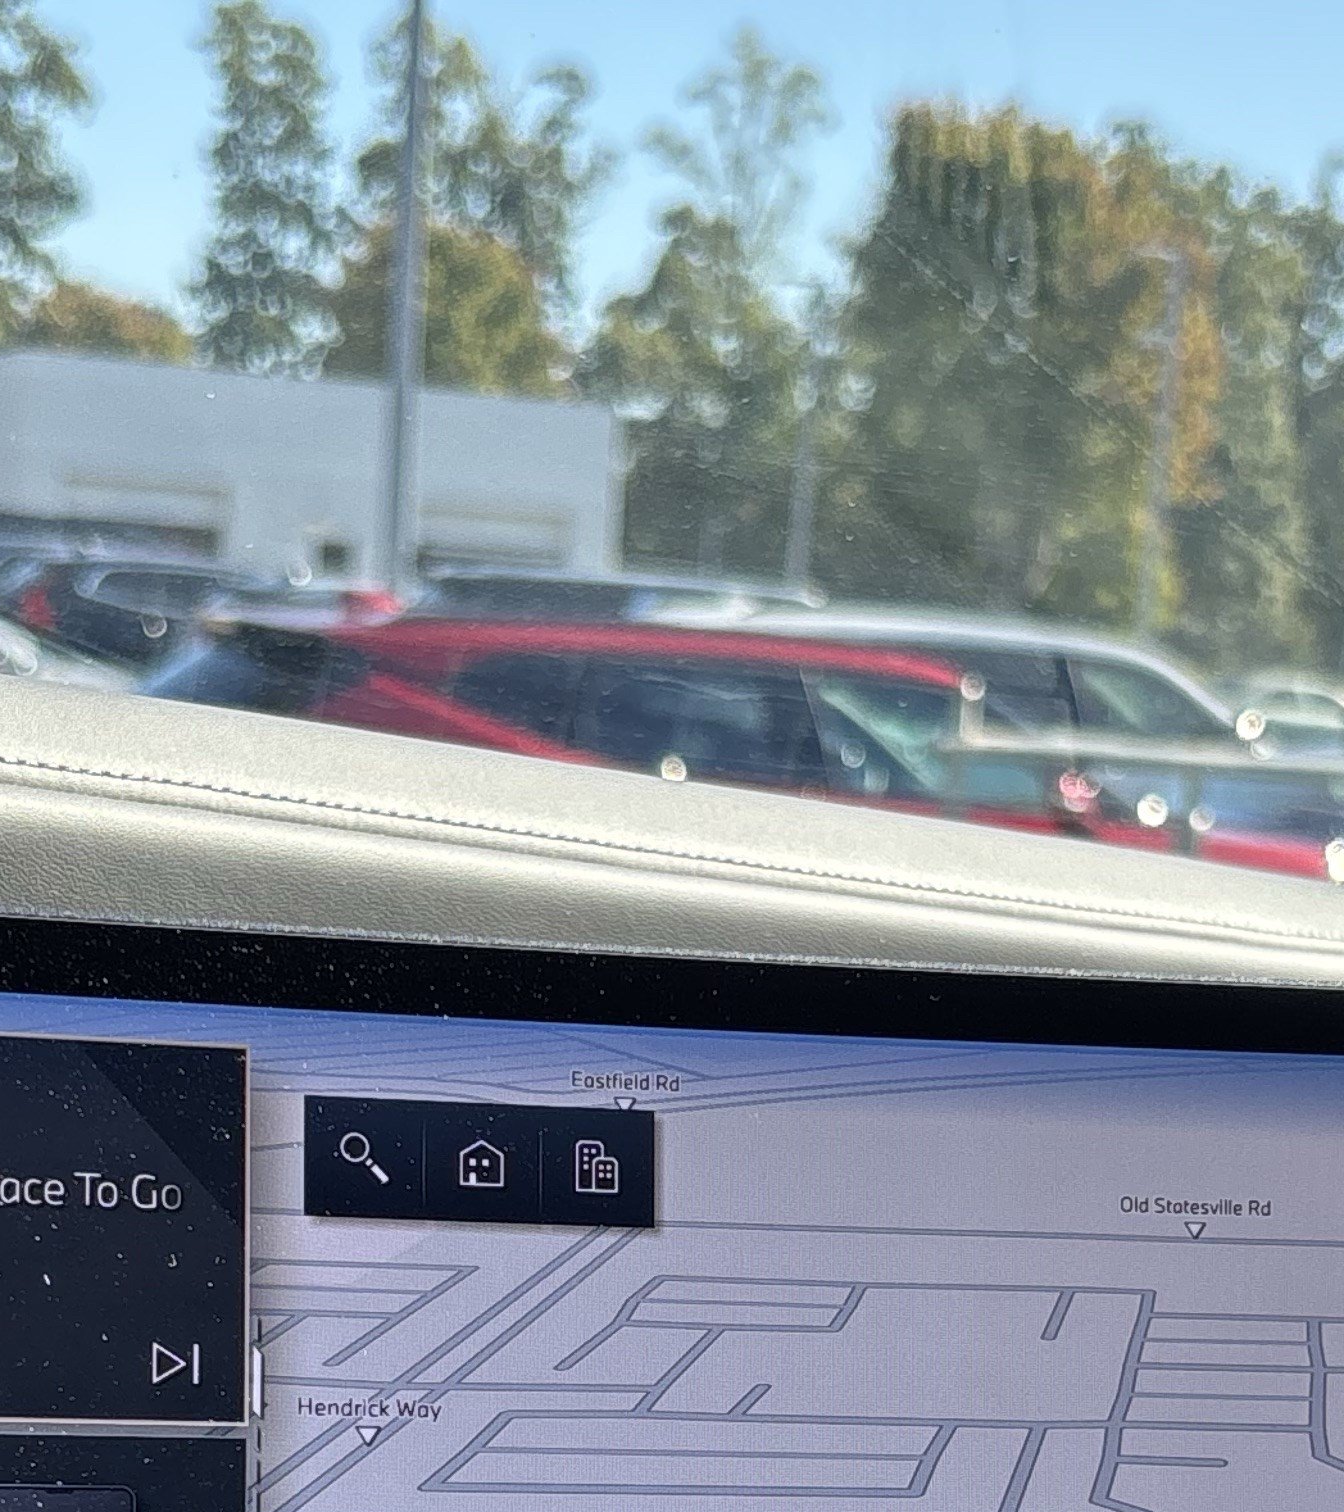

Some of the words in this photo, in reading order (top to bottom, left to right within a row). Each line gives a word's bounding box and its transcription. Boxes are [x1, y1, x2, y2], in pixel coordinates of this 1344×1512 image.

[571, 1070, 650, 1091] Eastfield
[656, 1074, 680, 1092] Rd
[74, 1172, 119, 1208] To
[131, 1174, 183, 1211] Go
[1120, 1196, 1149, 1214] Old
[1154, 1197, 1243, 1216] Statesville
[1249, 1199, 1271, 1216] Rd
[297, 1397, 390, 1418] Hendrick
[396, 1399, 442, 1422] Way
